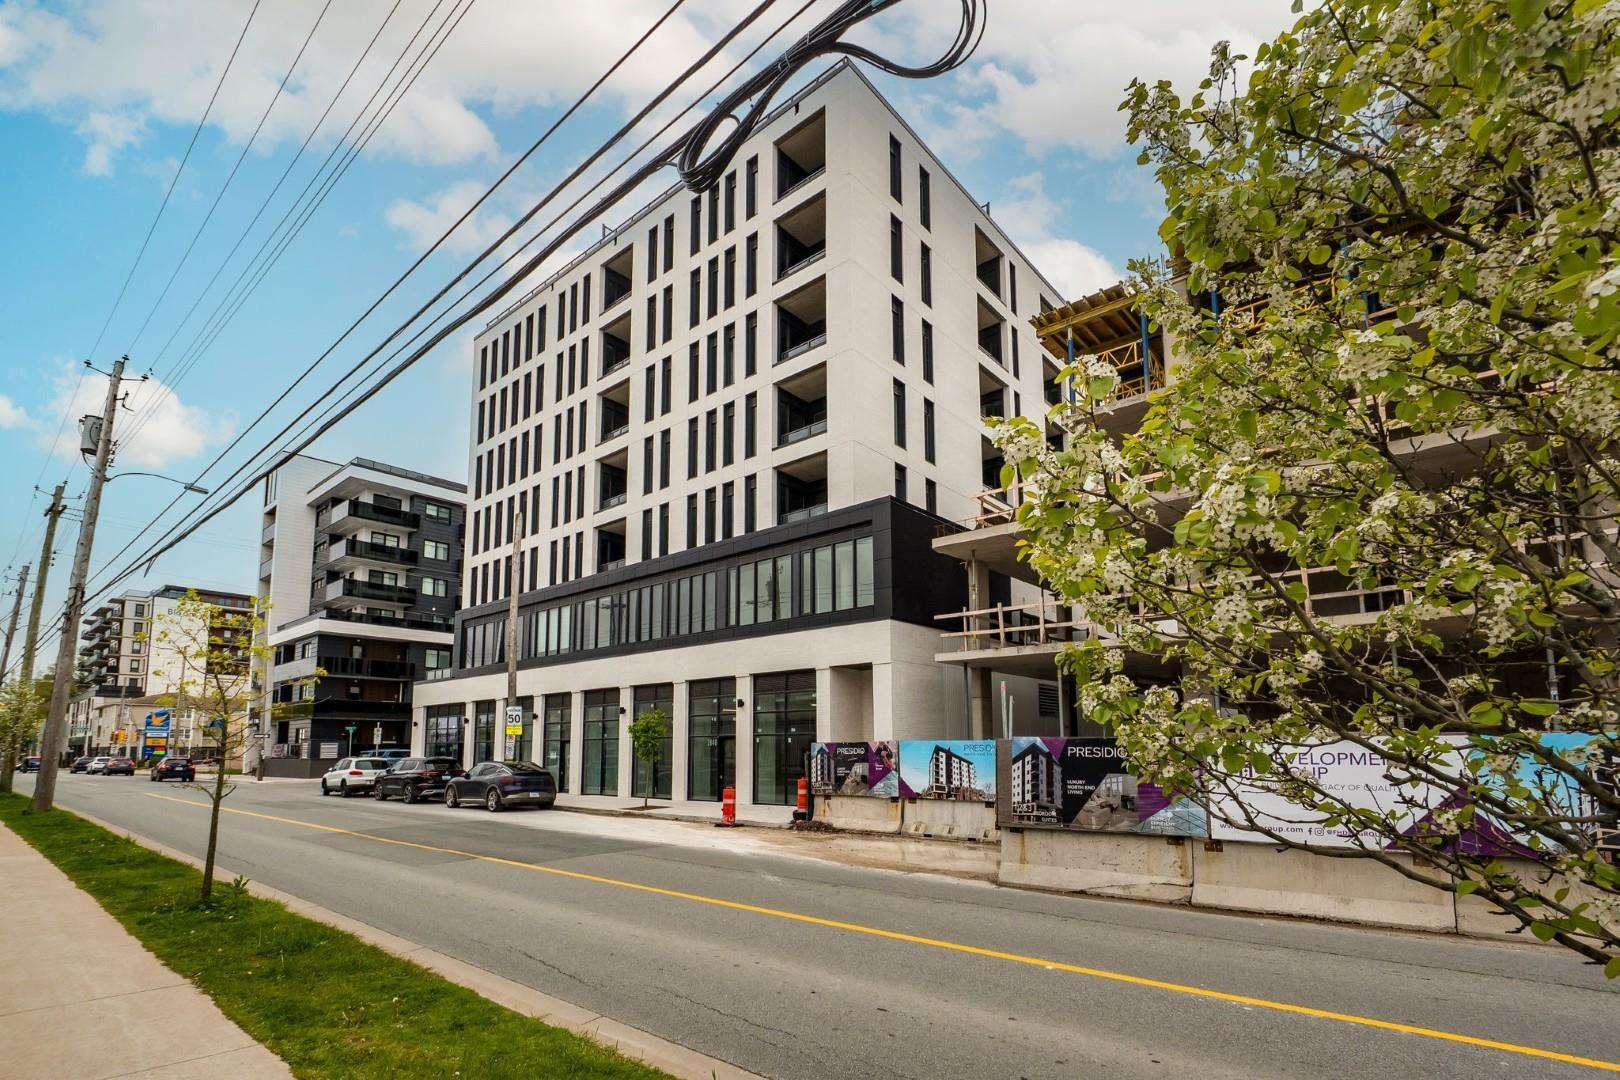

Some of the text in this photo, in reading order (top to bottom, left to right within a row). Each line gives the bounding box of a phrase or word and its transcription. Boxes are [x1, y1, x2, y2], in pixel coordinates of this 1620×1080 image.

[508, 714, 521, 724] 50
[836, 747, 865, 755] PRESIDIO
[1067, 746, 1128, 758] PRESIDIO
[1363, 784, 1403, 792] QUALITY
